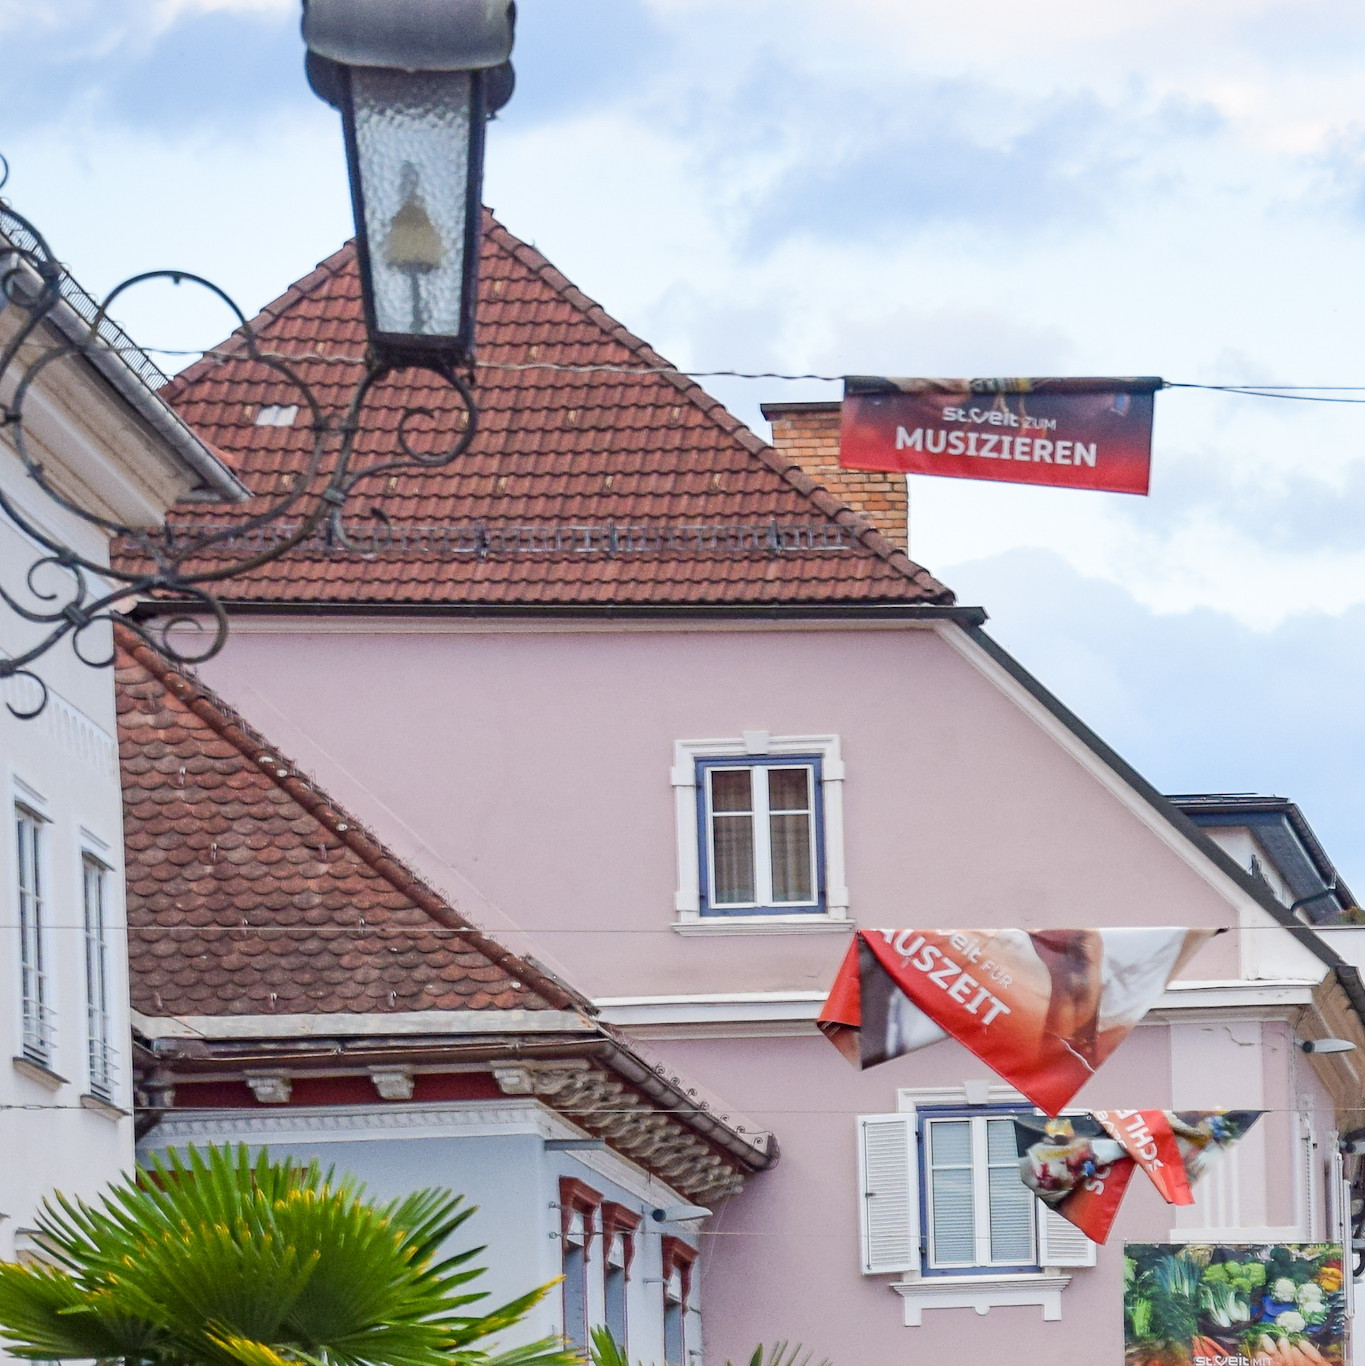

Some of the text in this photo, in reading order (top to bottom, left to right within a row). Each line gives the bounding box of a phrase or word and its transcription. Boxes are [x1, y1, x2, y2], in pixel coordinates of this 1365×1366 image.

[1025, 417, 1056, 431] ZUM
[896, 425, 1097, 468] MUSIZIEREN
[1253, 1357, 1271, 1366] MIT
